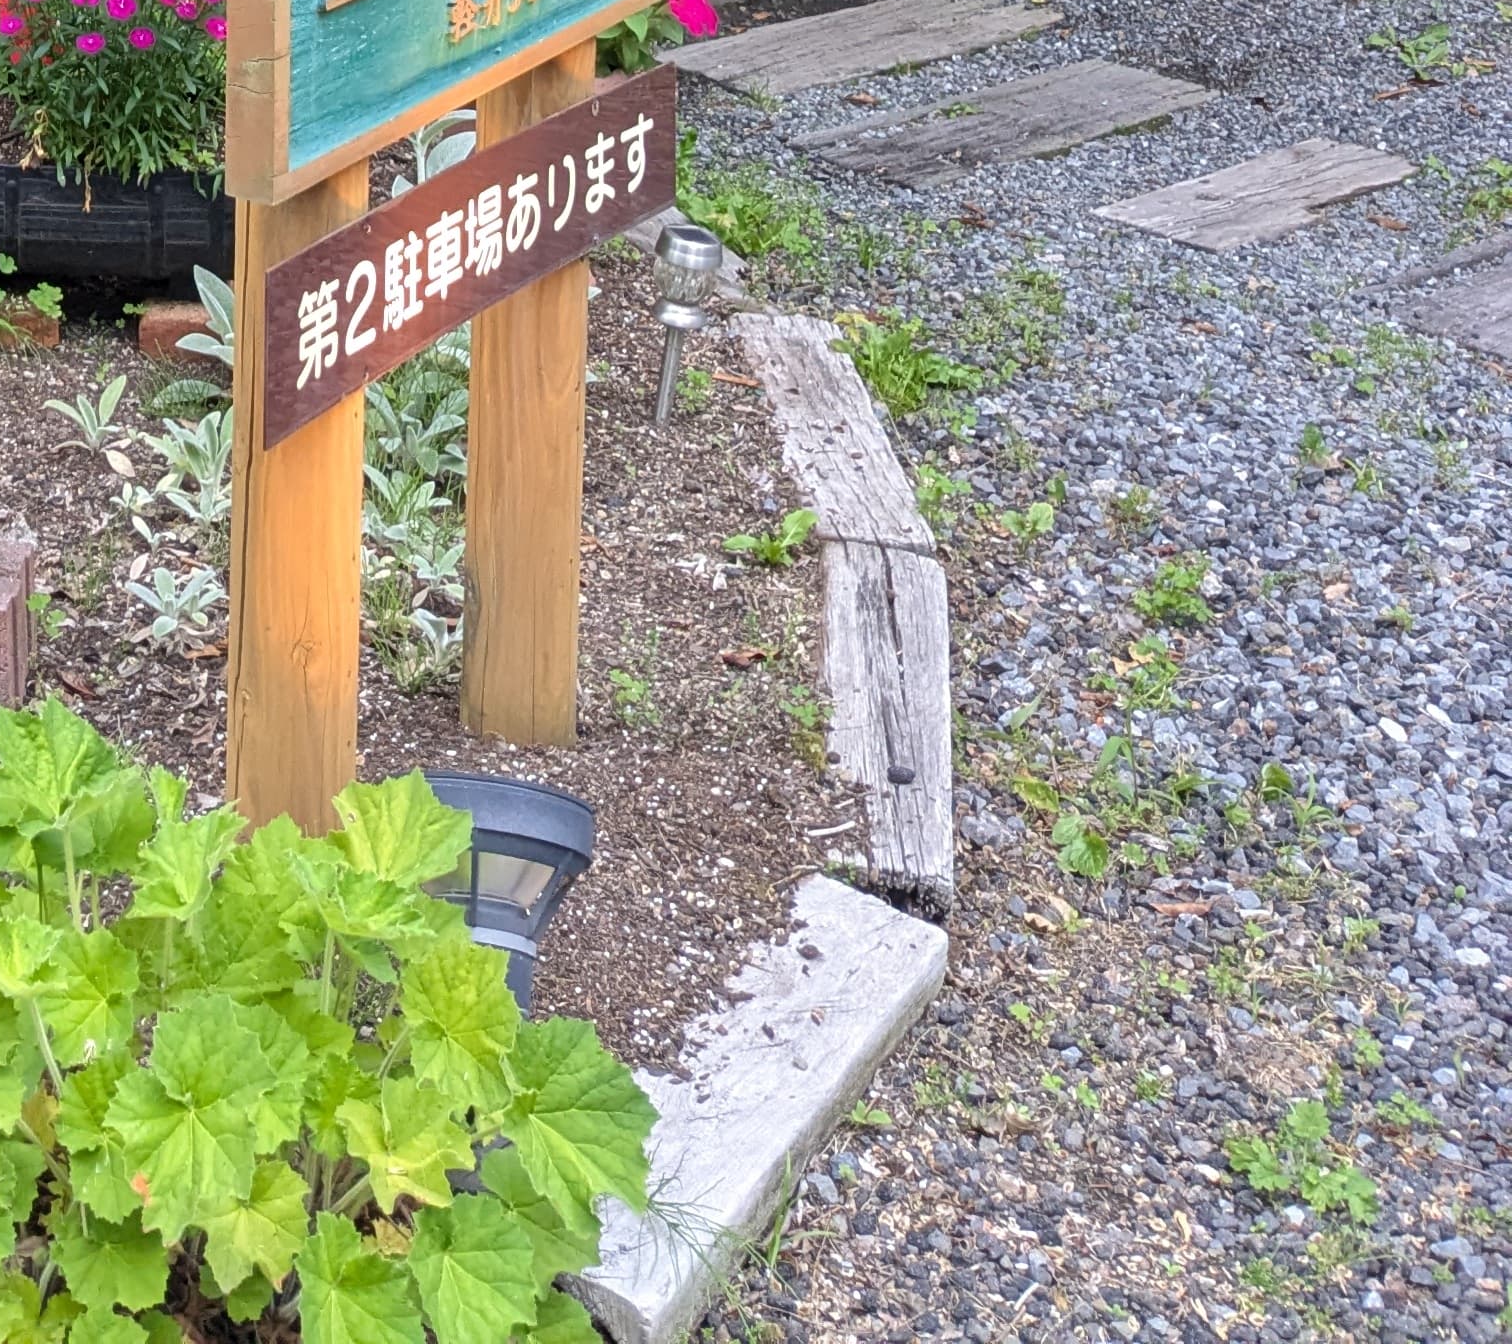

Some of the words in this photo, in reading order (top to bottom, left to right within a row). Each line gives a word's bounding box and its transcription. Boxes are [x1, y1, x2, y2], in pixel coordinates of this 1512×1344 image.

[296, 112, 654, 390] 第2駐車場あります
